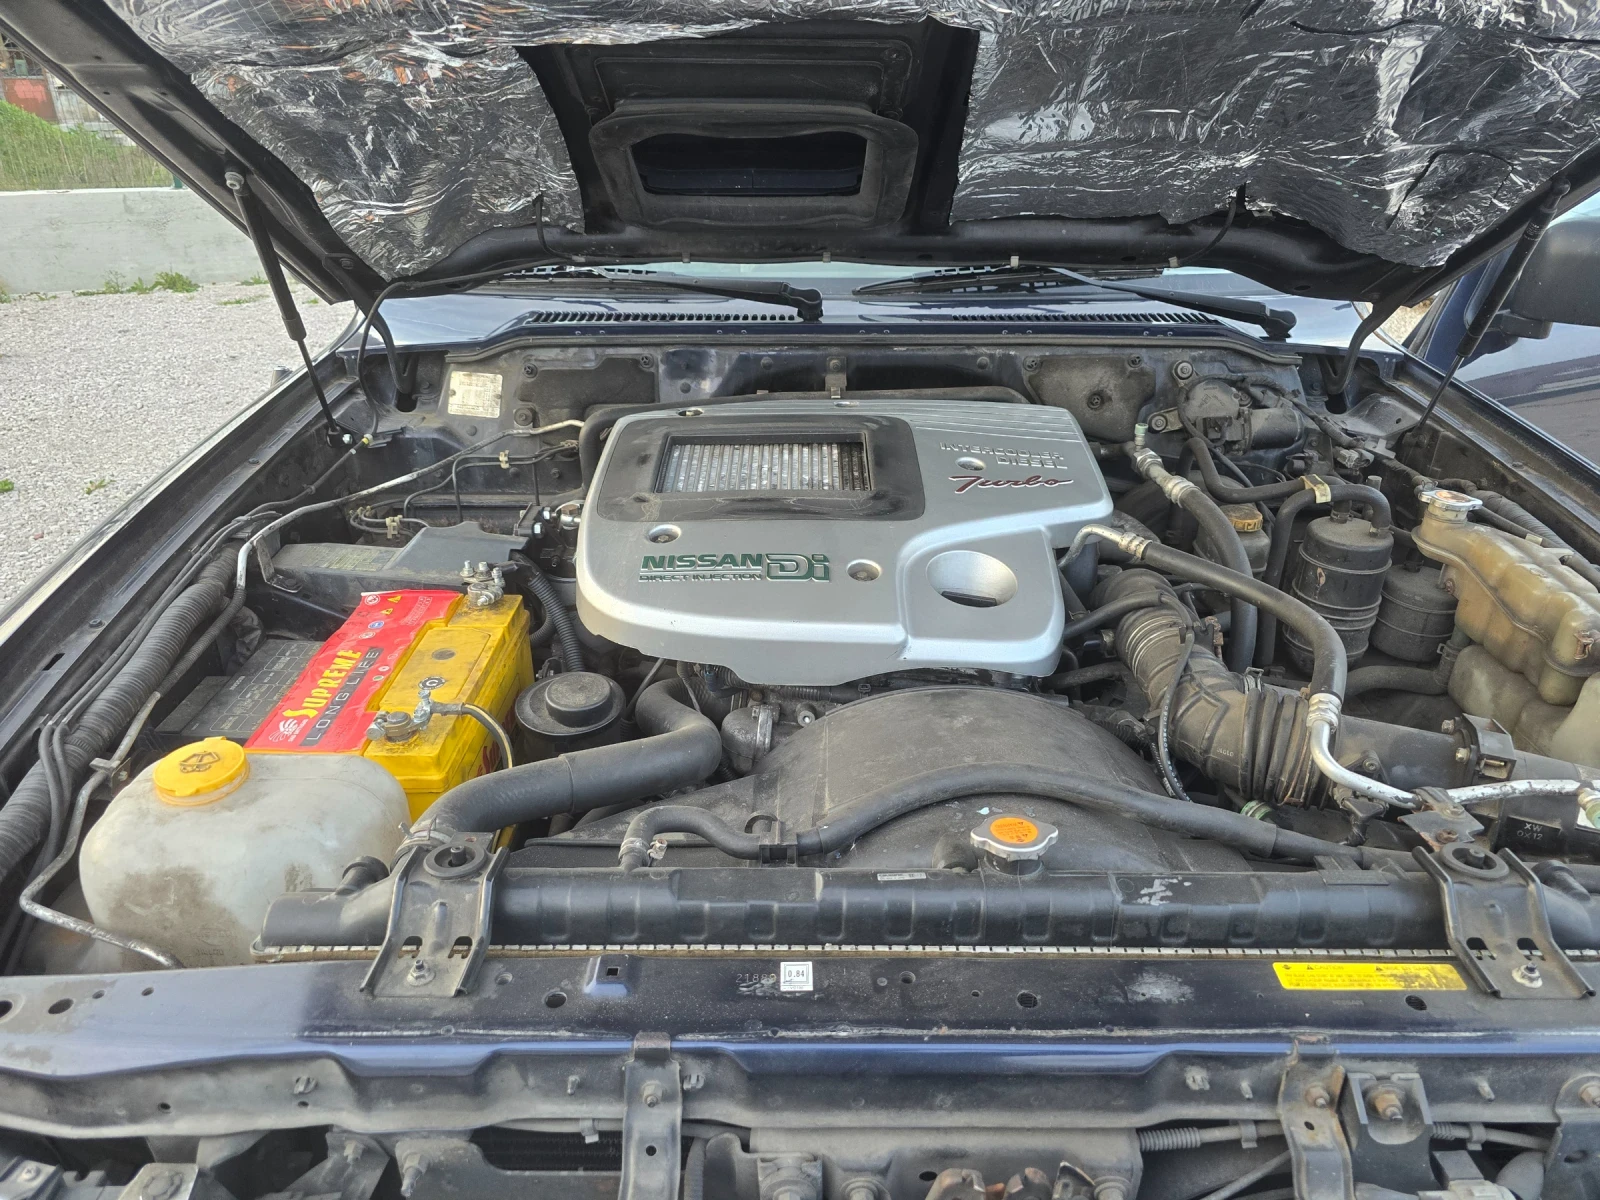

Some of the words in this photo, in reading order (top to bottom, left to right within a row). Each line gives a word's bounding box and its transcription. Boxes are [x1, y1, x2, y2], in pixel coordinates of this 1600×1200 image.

[940, 442, 1064, 460] INTERCOOLER
[996, 455, 1068, 469] DIESEL
[949, 475, 1074, 494] Turbo
[640, 554, 762, 570] NISSAN
[638, 574, 690, 582] DIRECT
[692, 573, 762, 582] INJECTION
[282, 649, 362, 719] SUPREME
[306, 692, 350, 740] LONG
[346, 651, 380, 685] LIFE
[787, 969, 805, 978] 0.84
